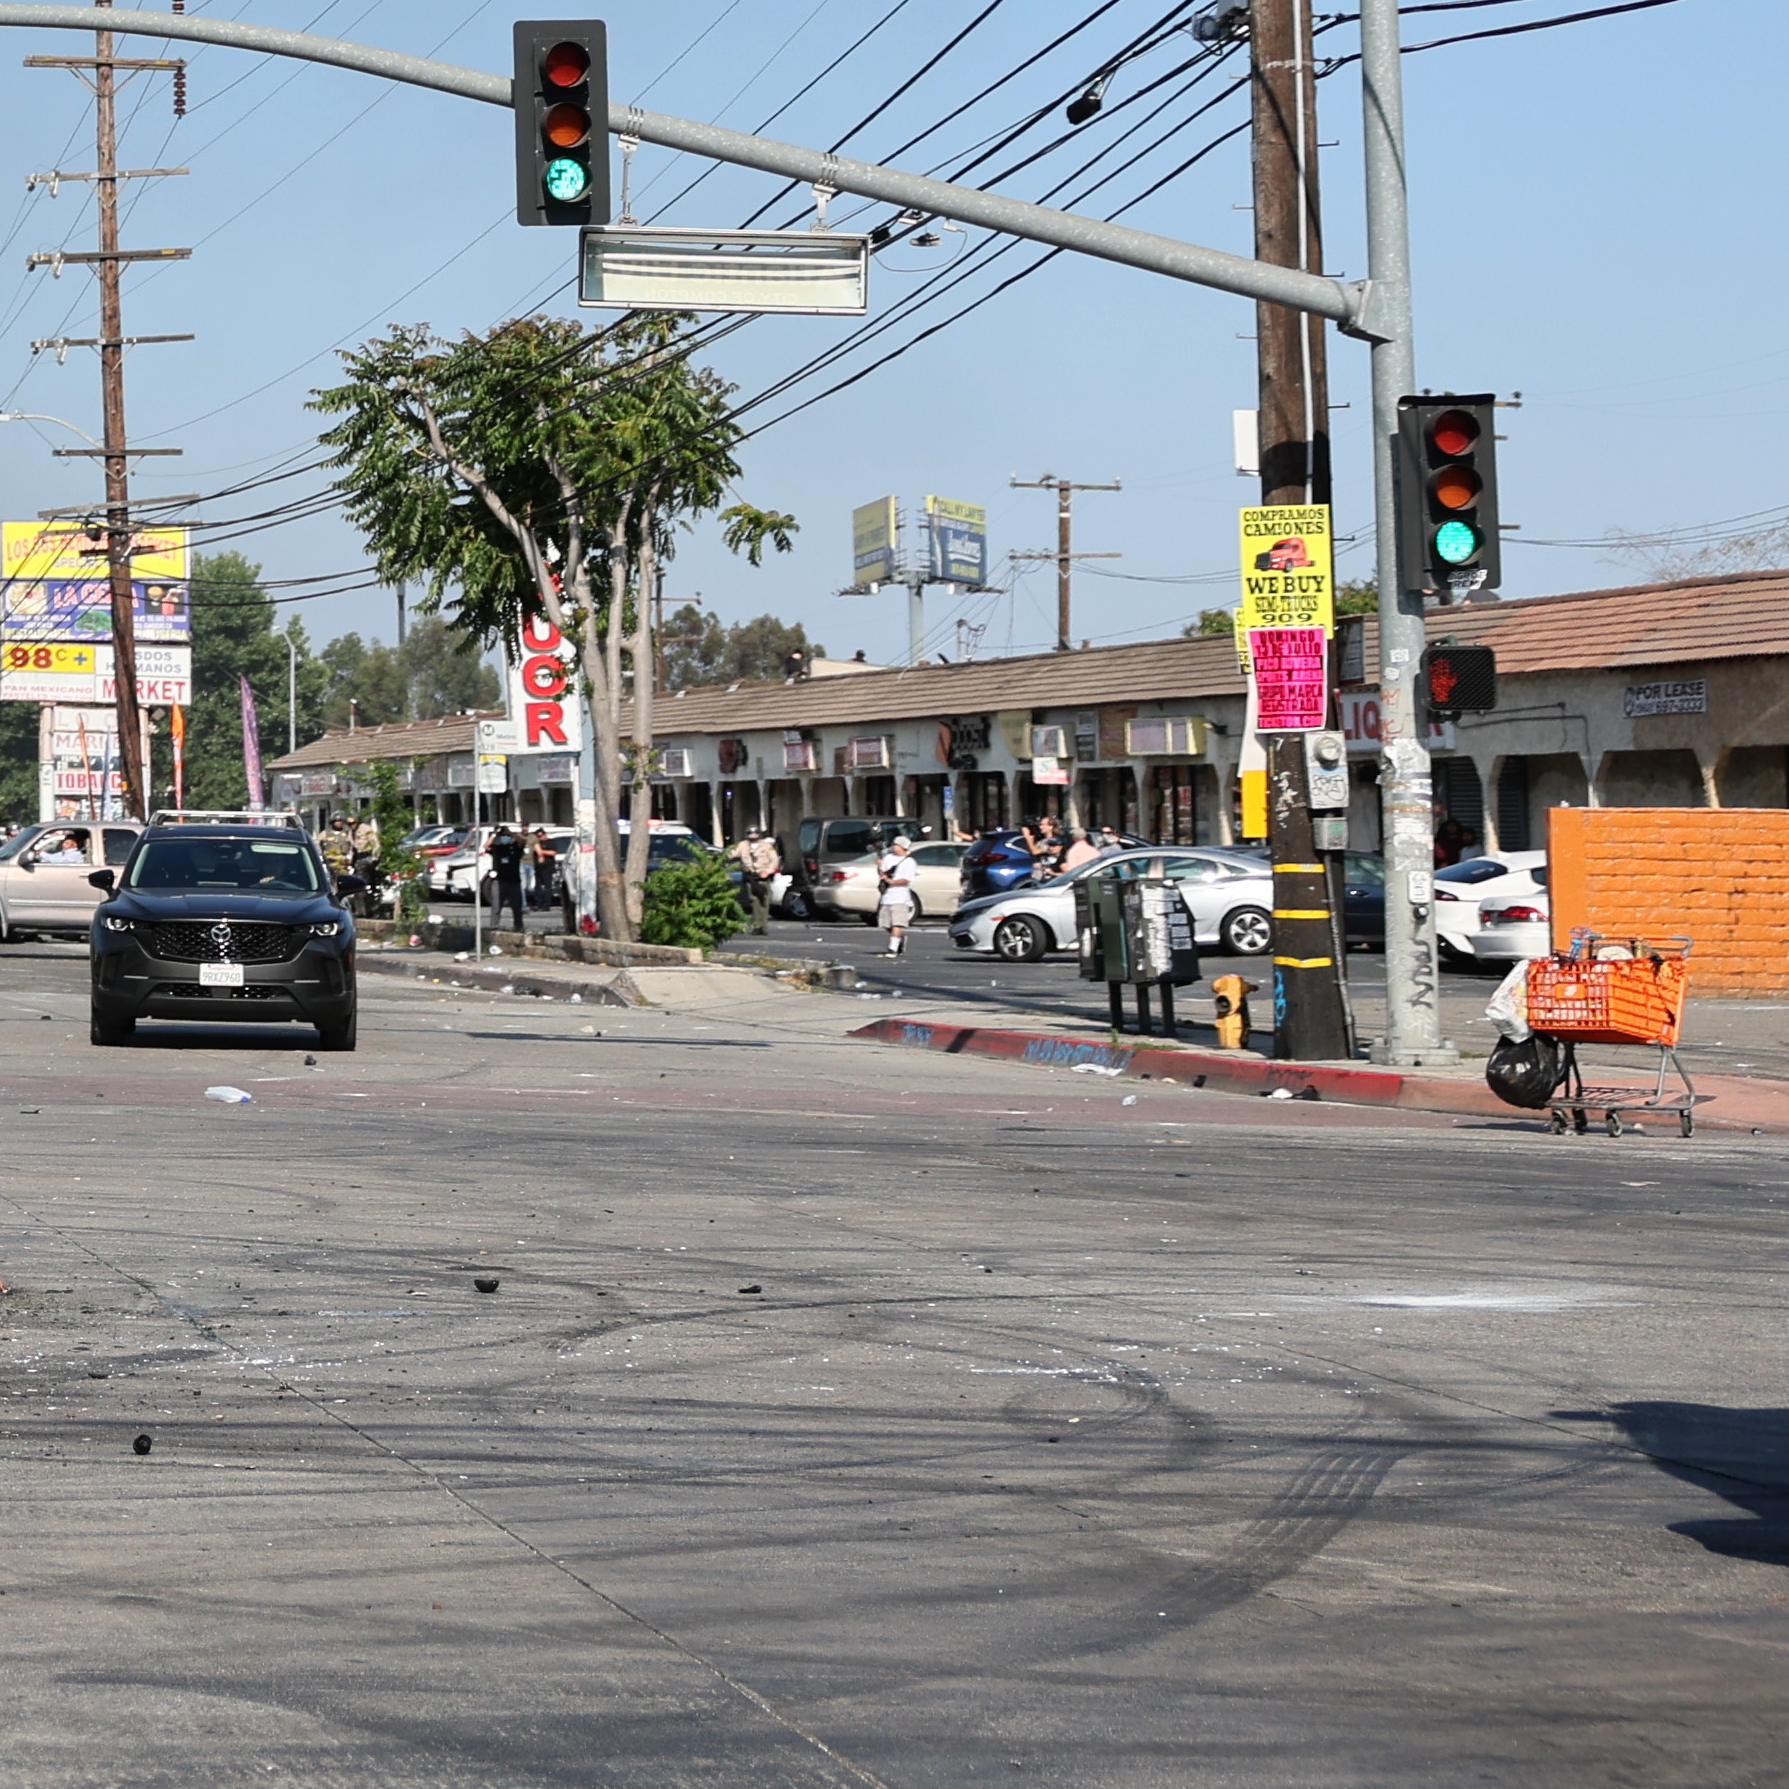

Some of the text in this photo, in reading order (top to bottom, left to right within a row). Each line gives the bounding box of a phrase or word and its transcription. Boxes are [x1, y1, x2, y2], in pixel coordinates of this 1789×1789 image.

[1243, 509, 1325, 522] COMPRAMOS
[1243, 522, 1325, 536] CAMIONES
[7, 540, 30, 561] LOS
[1246, 576, 1325, 594] WE BUY
[53, 585, 78, 609] LA
[1255, 595, 1318, 613] SEMI-TRUCKS
[1261, 613, 1312, 623] 909
[1259, 630, 1316, 644] DOMINGO
[10, 648, 53, 669] 98
[131, 651, 173, 661] SDOS
[106, 662, 183, 674] HMANOS
[31, 685, 93, 694] MEXICANO
[103, 680, 186, 701] MRKET
[1635, 681, 1704, 700] FOR LEASE
[56, 772, 124, 790] TOBAC
[202, 971, 241, 982] 9RXZ960
